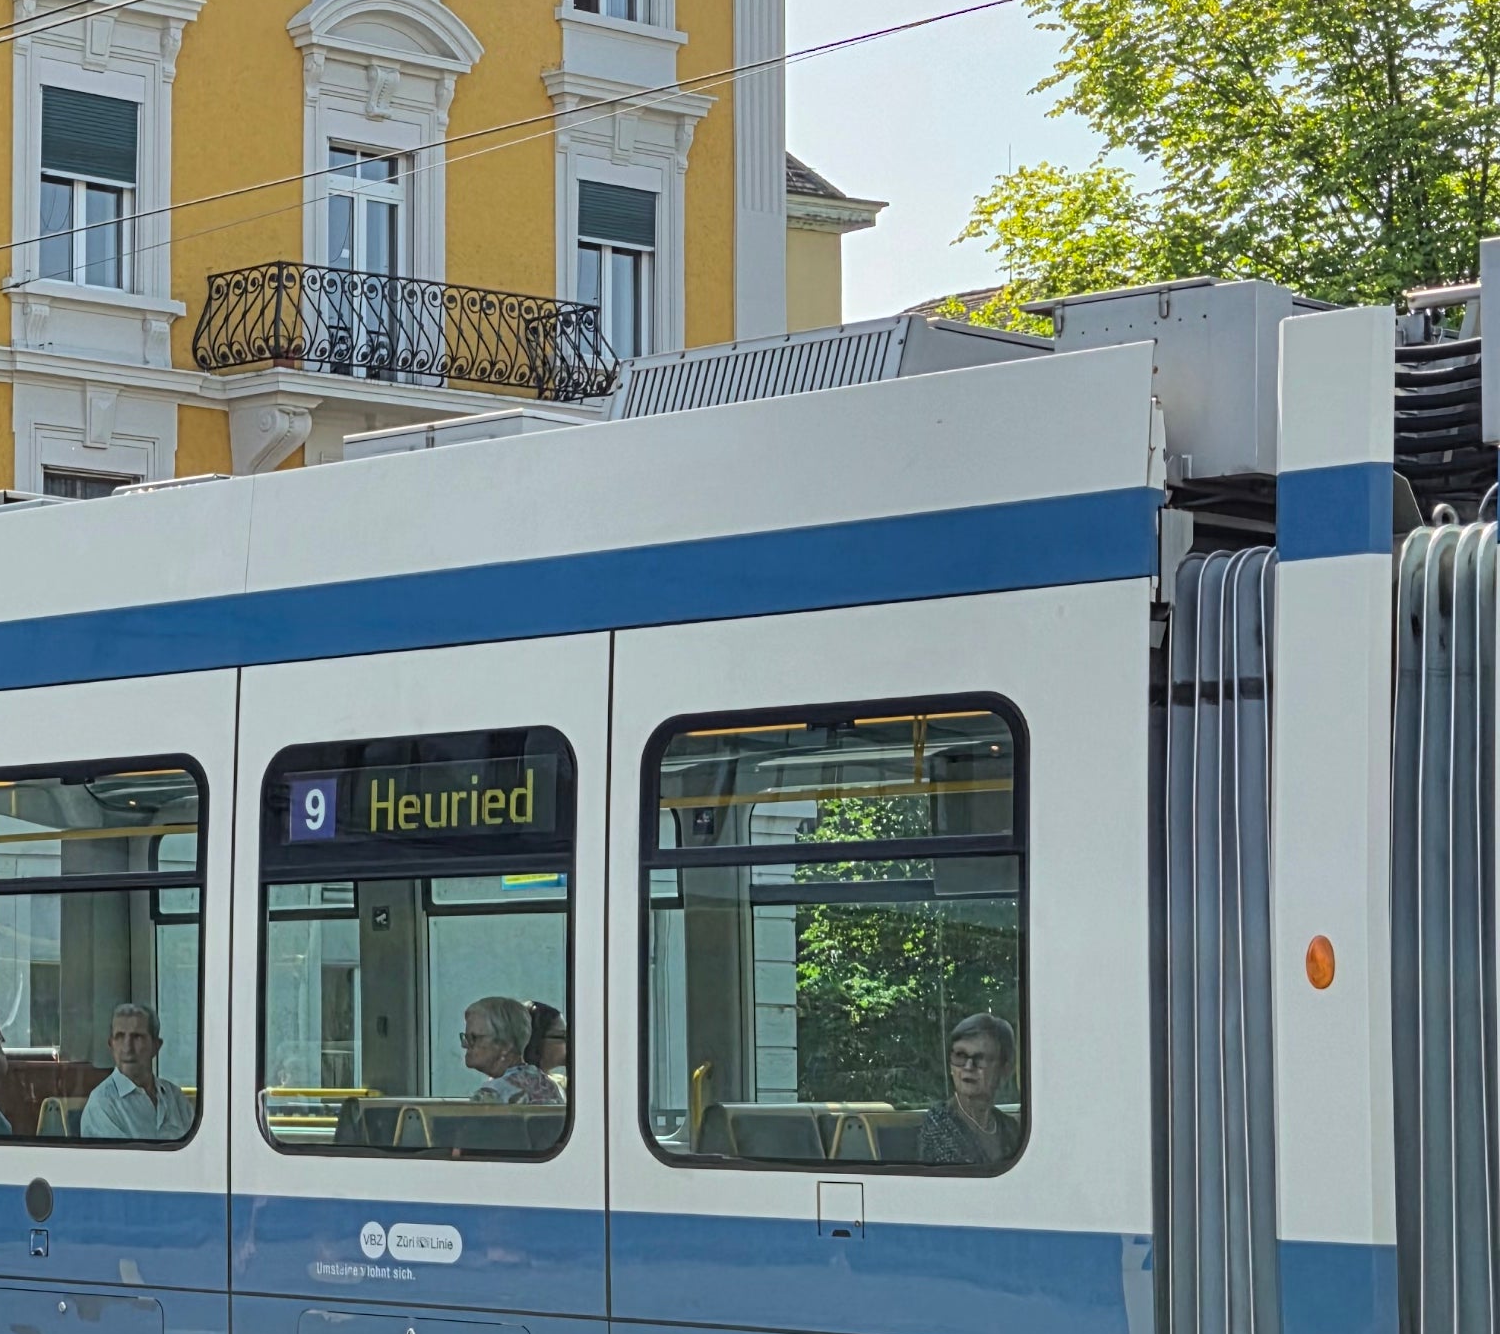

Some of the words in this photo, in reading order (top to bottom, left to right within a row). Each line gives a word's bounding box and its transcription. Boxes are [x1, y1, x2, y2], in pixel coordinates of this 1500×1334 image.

[305, 788, 326, 831] 9
[370, 769, 534, 833] Heuried
[362, 1233, 383, 1246] VBZ
[396, 1235, 415, 1249] Züri
[430, 1237, 453, 1250] Linie
[366, 1265, 390, 1279] lohnt
[393, 1267, 416, 1281] sich.
